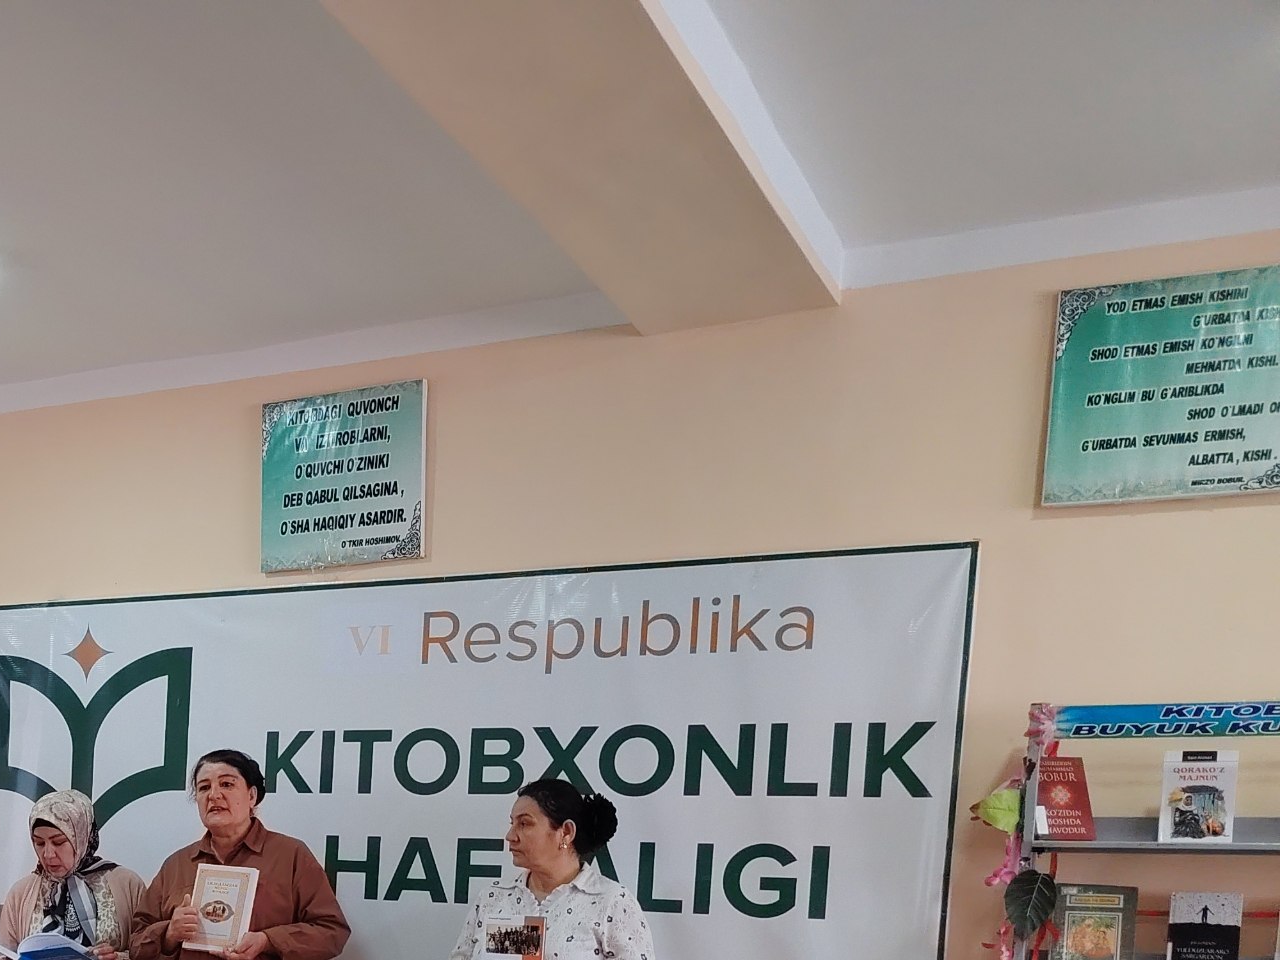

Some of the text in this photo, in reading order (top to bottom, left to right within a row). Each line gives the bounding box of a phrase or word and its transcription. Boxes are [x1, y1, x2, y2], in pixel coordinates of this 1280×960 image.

[1106, 297, 1126, 314] YOD
[1131, 294, 1166, 312] ETMAS
[1170, 291, 1203, 308] EMISH
[1090, 345, 1119, 361] SHOD
[1123, 342, 1158, 358] ETMAS
[1162, 338, 1195, 355] EMISH
[1247, 354, 1279, 369] KISHI.
[1140, 387, 1156, 403] BU
[347, 395, 400, 418] QUVONCH
[1187, 406, 1216, 421] SHOD
[1142, 432, 1199, 449] SEVUNMAS
[1203, 428, 1247, 445] ERMISH,
[283, 492, 304, 509] DEB
[305, 488, 340, 507] QABUL
[313, 513, 356, 533] HAQIQIY
[358, 508, 407, 528] ASARDIR.
[348, 593, 816, 675] VI Respublika
[1070, 722, 1218, 738] BUYUK
[263, 718, 936, 801] KITOBXONLIK
[1039, 772, 1077, 782] BOBUR
